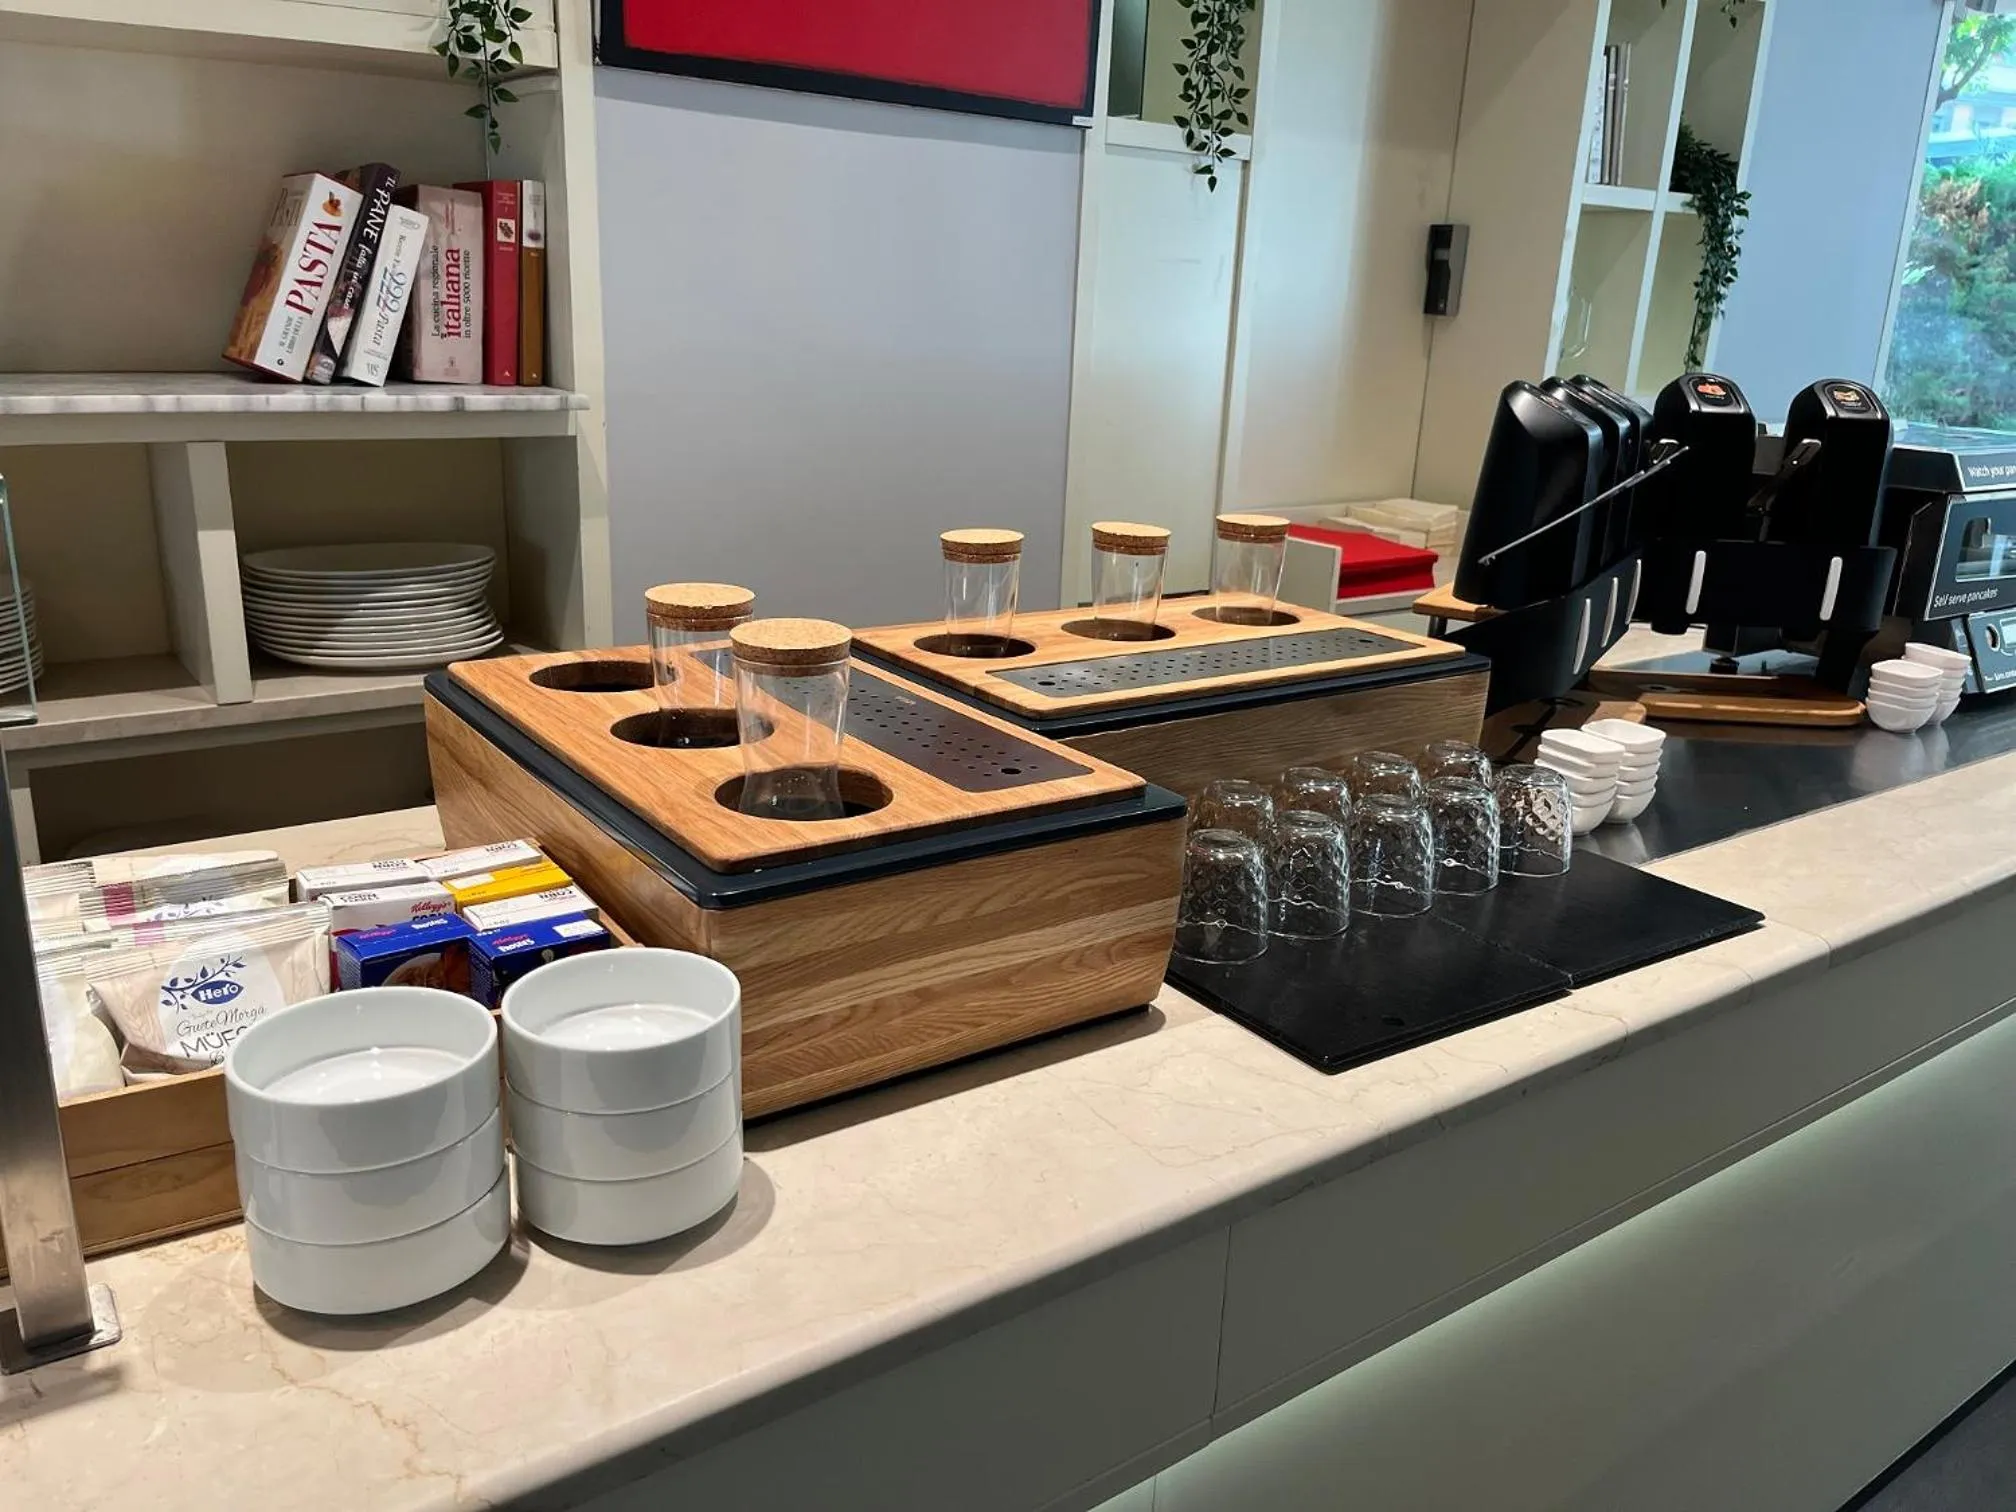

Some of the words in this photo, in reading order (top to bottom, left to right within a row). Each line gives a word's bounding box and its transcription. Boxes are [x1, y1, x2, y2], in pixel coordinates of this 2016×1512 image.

[363, 187, 391, 244] PANE
[283, 220, 343, 316] PASTA
[430, 244, 441, 289] regionale
[440, 248, 461, 339] italiana
[462, 281, 471, 304] 5000
[430, 291, 441, 323] cucina
[462, 306, 471, 327] oltre
[431, 325, 441, 337] La
[1966, 587, 1999, 604] pancakes
[410, 900, 448, 915] Kellogg's
[198, 983, 239, 1001] Hero
